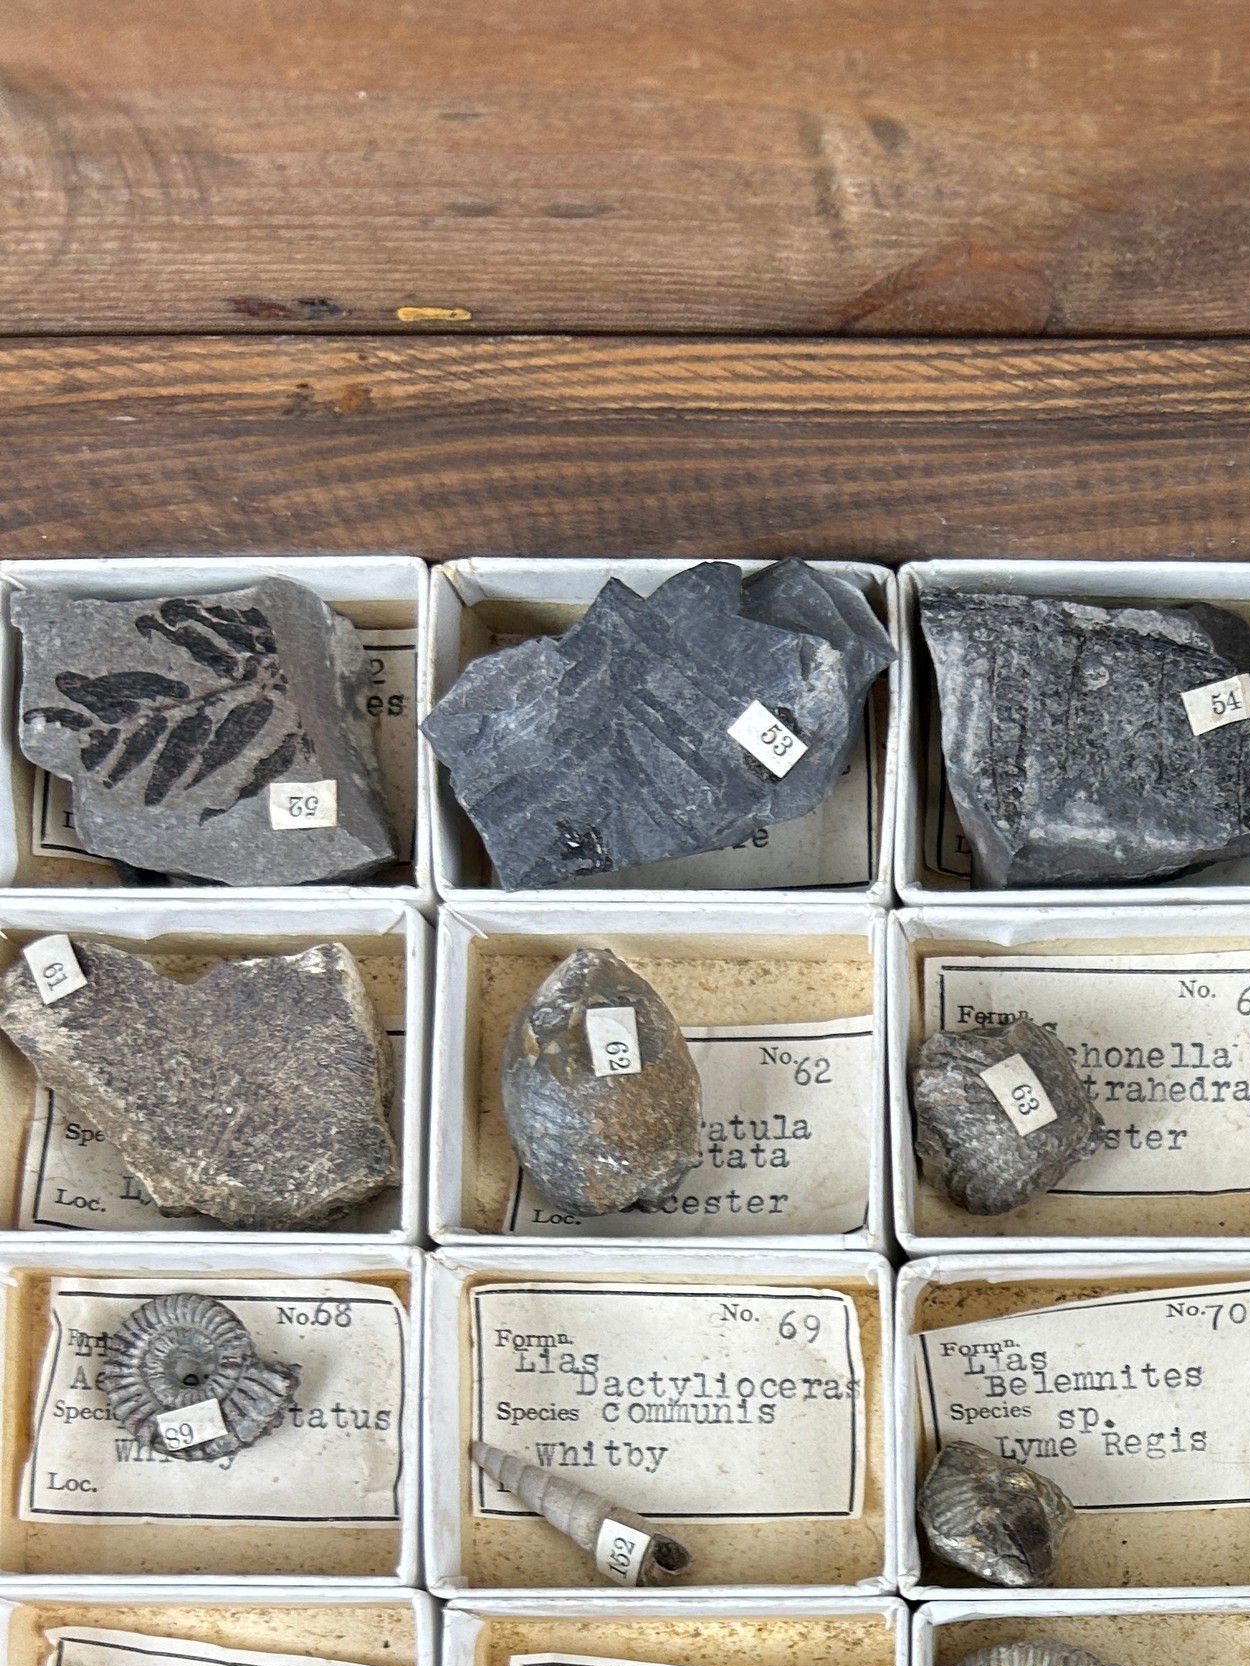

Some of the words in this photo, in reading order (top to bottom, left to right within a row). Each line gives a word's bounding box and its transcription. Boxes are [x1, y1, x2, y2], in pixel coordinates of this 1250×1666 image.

[1211, 694, 1242, 715] 54
[760, 723, 794, 757] 53
[289, 795, 318, 818] 52
[41, 961, 69, 992] 61
[1178, 980, 1217, 999] No.
[605, 1040, 631, 1072] 62
[760, 1047, 799, 1065] No.
[794, 1057, 833, 1087] 62
[1010, 1083, 1040, 1115] 63
[55, 1188, 106, 1213] Loc.
[532, 1209, 581, 1226] Loc.
[276, 1307, 316, 1326] No.
[314, 1302, 353, 1328] 68
[719, 1304, 760, 1322] No.
[778, 1311, 821, 1343] 69
[1165, 1303, 1207, 1319] No.
[1207, 1303, 1248, 1331] 70
[514, 1348, 600, 1375] Lias
[964, 1350, 1049, 1375] Lias
[576, 1373, 861, 1404] Dactylioceras
[985, 1364, 1204, 1398] Belemnites
[497, 1404, 579, 1424] Species
[950, 1402, 1032, 1424] Species
[1058, 1408, 1115, 1433] sp.
[535, 1442, 669, 1473] Whitby
[996, 1436, 1078, 1465] Lyme
[1104, 1427, 1208, 1461] Regis
[48, 1473, 98, 1492] Loc.
[607, 1536, 636, 1578] 152
